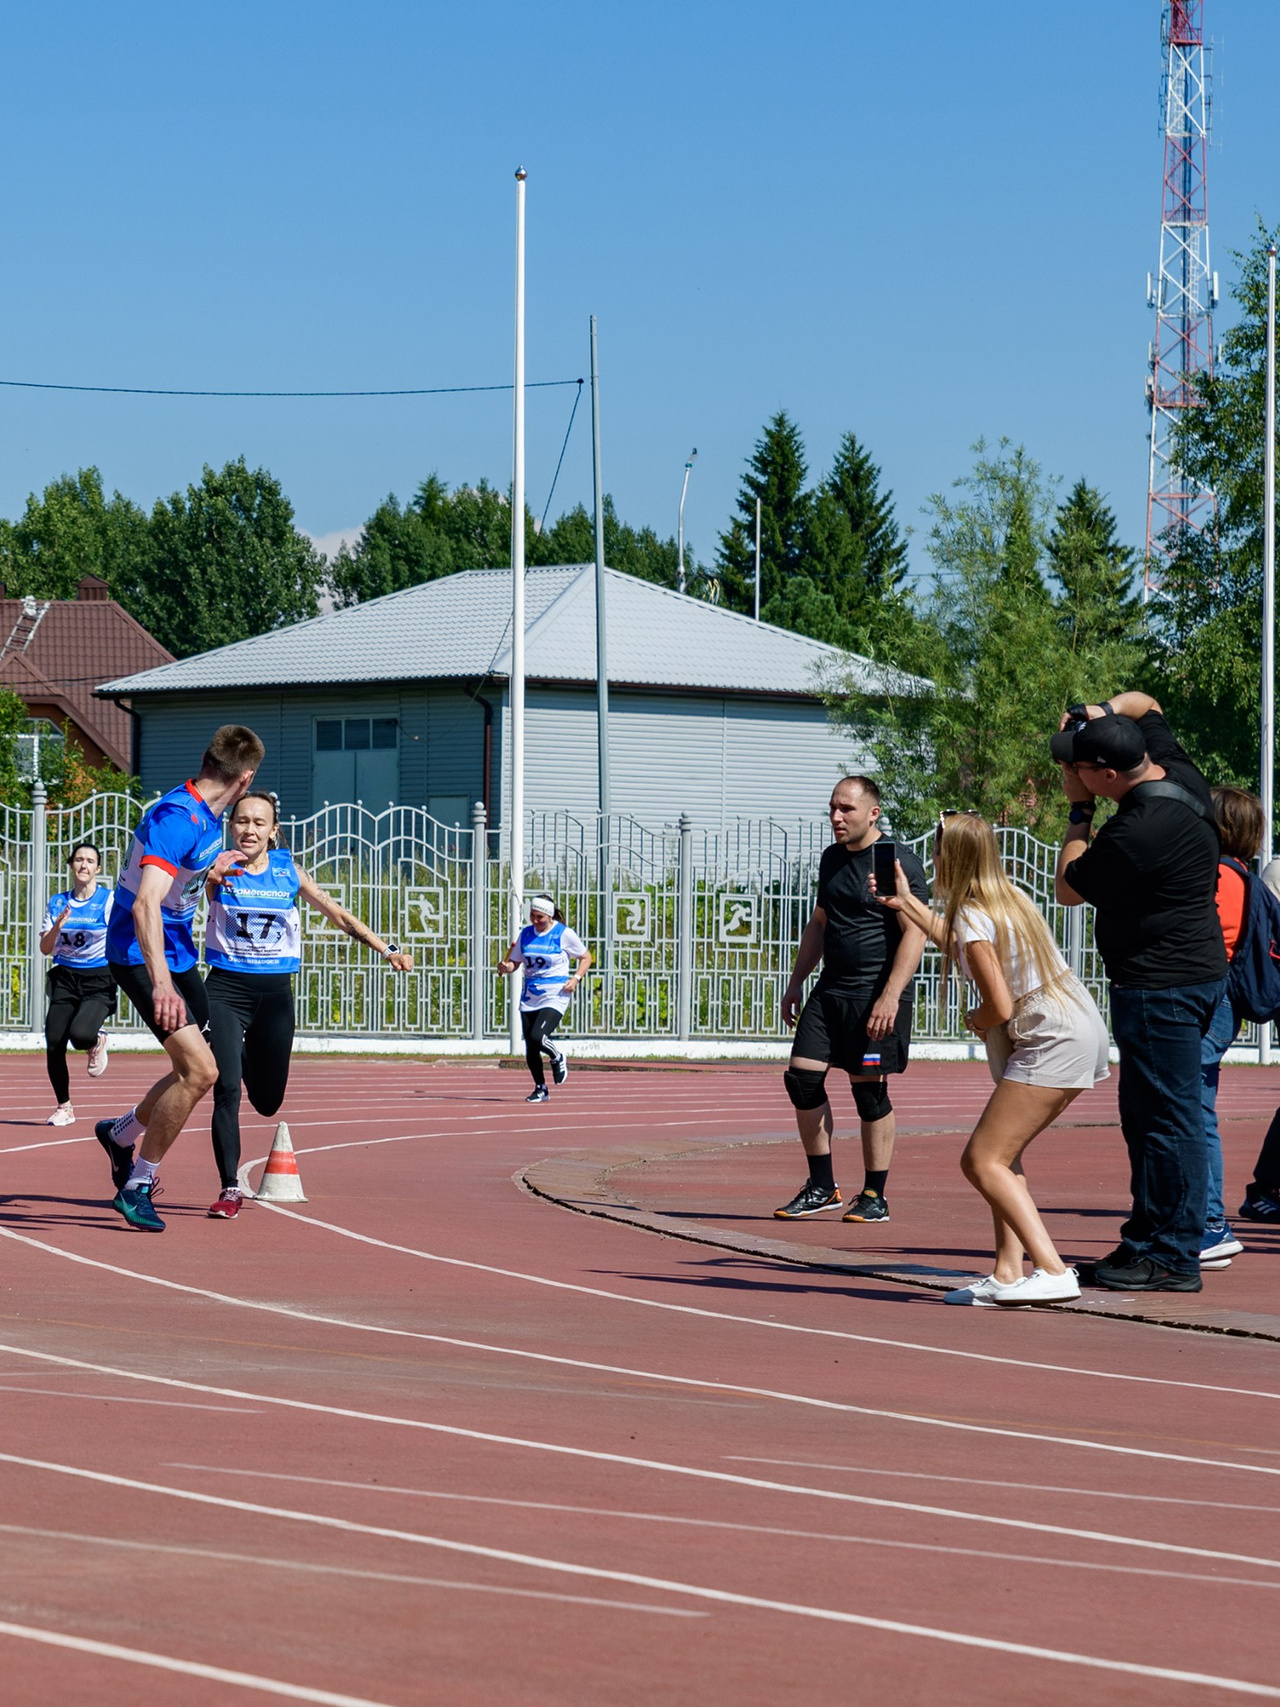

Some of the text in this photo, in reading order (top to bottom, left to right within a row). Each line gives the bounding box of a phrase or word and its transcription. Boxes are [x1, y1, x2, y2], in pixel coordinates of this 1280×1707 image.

[236, 912, 277, 939] 17
[60, 932, 86, 948] 18
[525, 956, 546, 969] 19
